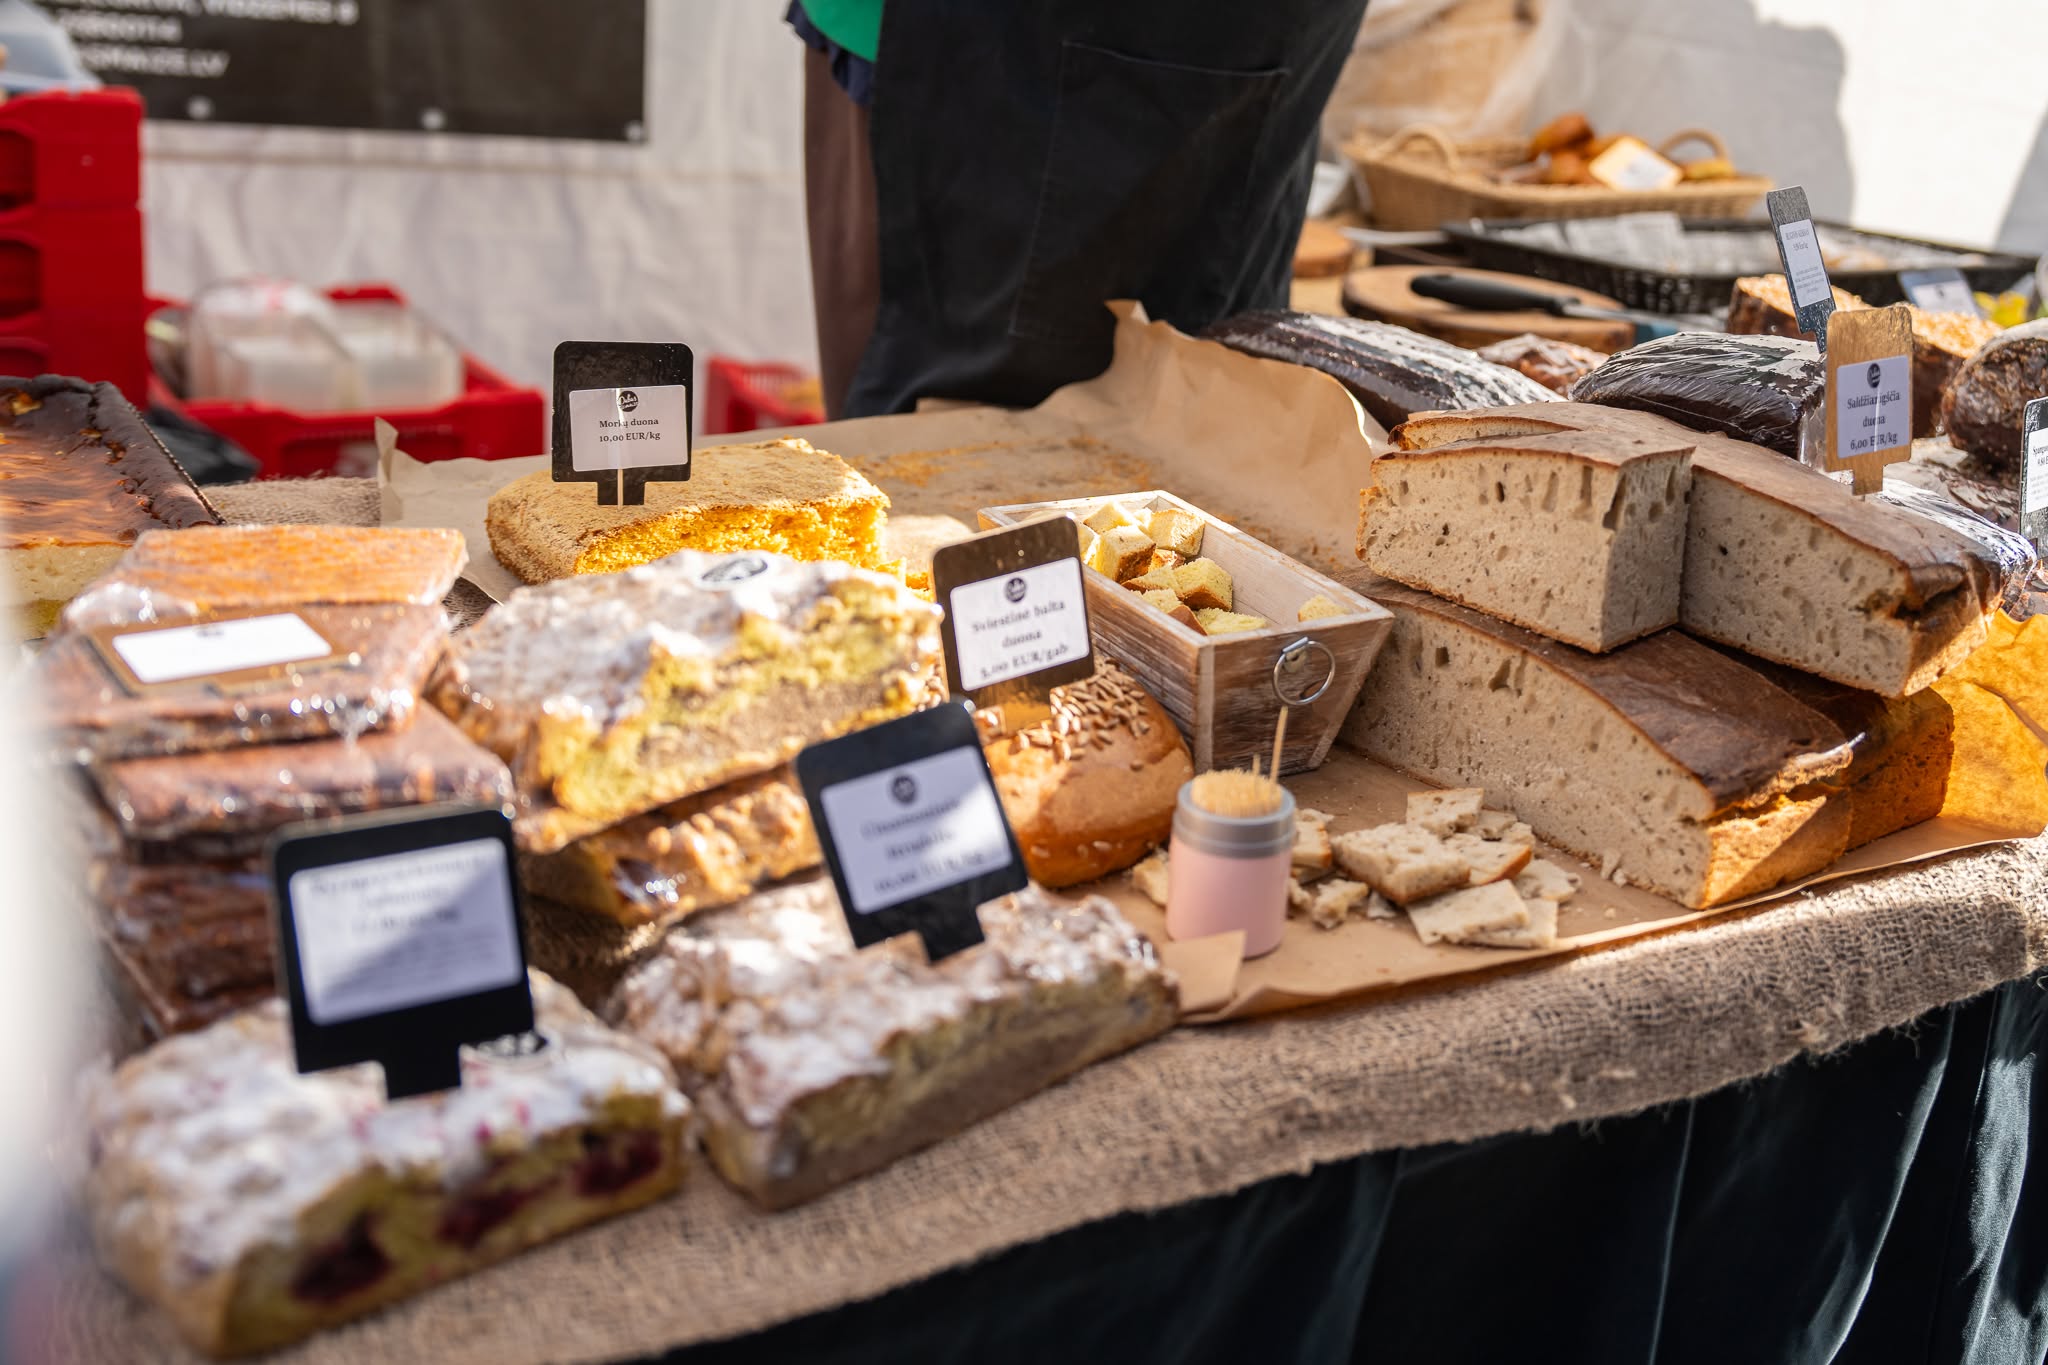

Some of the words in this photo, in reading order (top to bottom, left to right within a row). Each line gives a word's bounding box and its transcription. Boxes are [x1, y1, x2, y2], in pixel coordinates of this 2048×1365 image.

[630, 418, 659, 426] duona
[599, 434, 624, 442] 10,00
[626, 431, 661, 441] EUR/kg
[1850, 439, 1868, 452] 6,00
